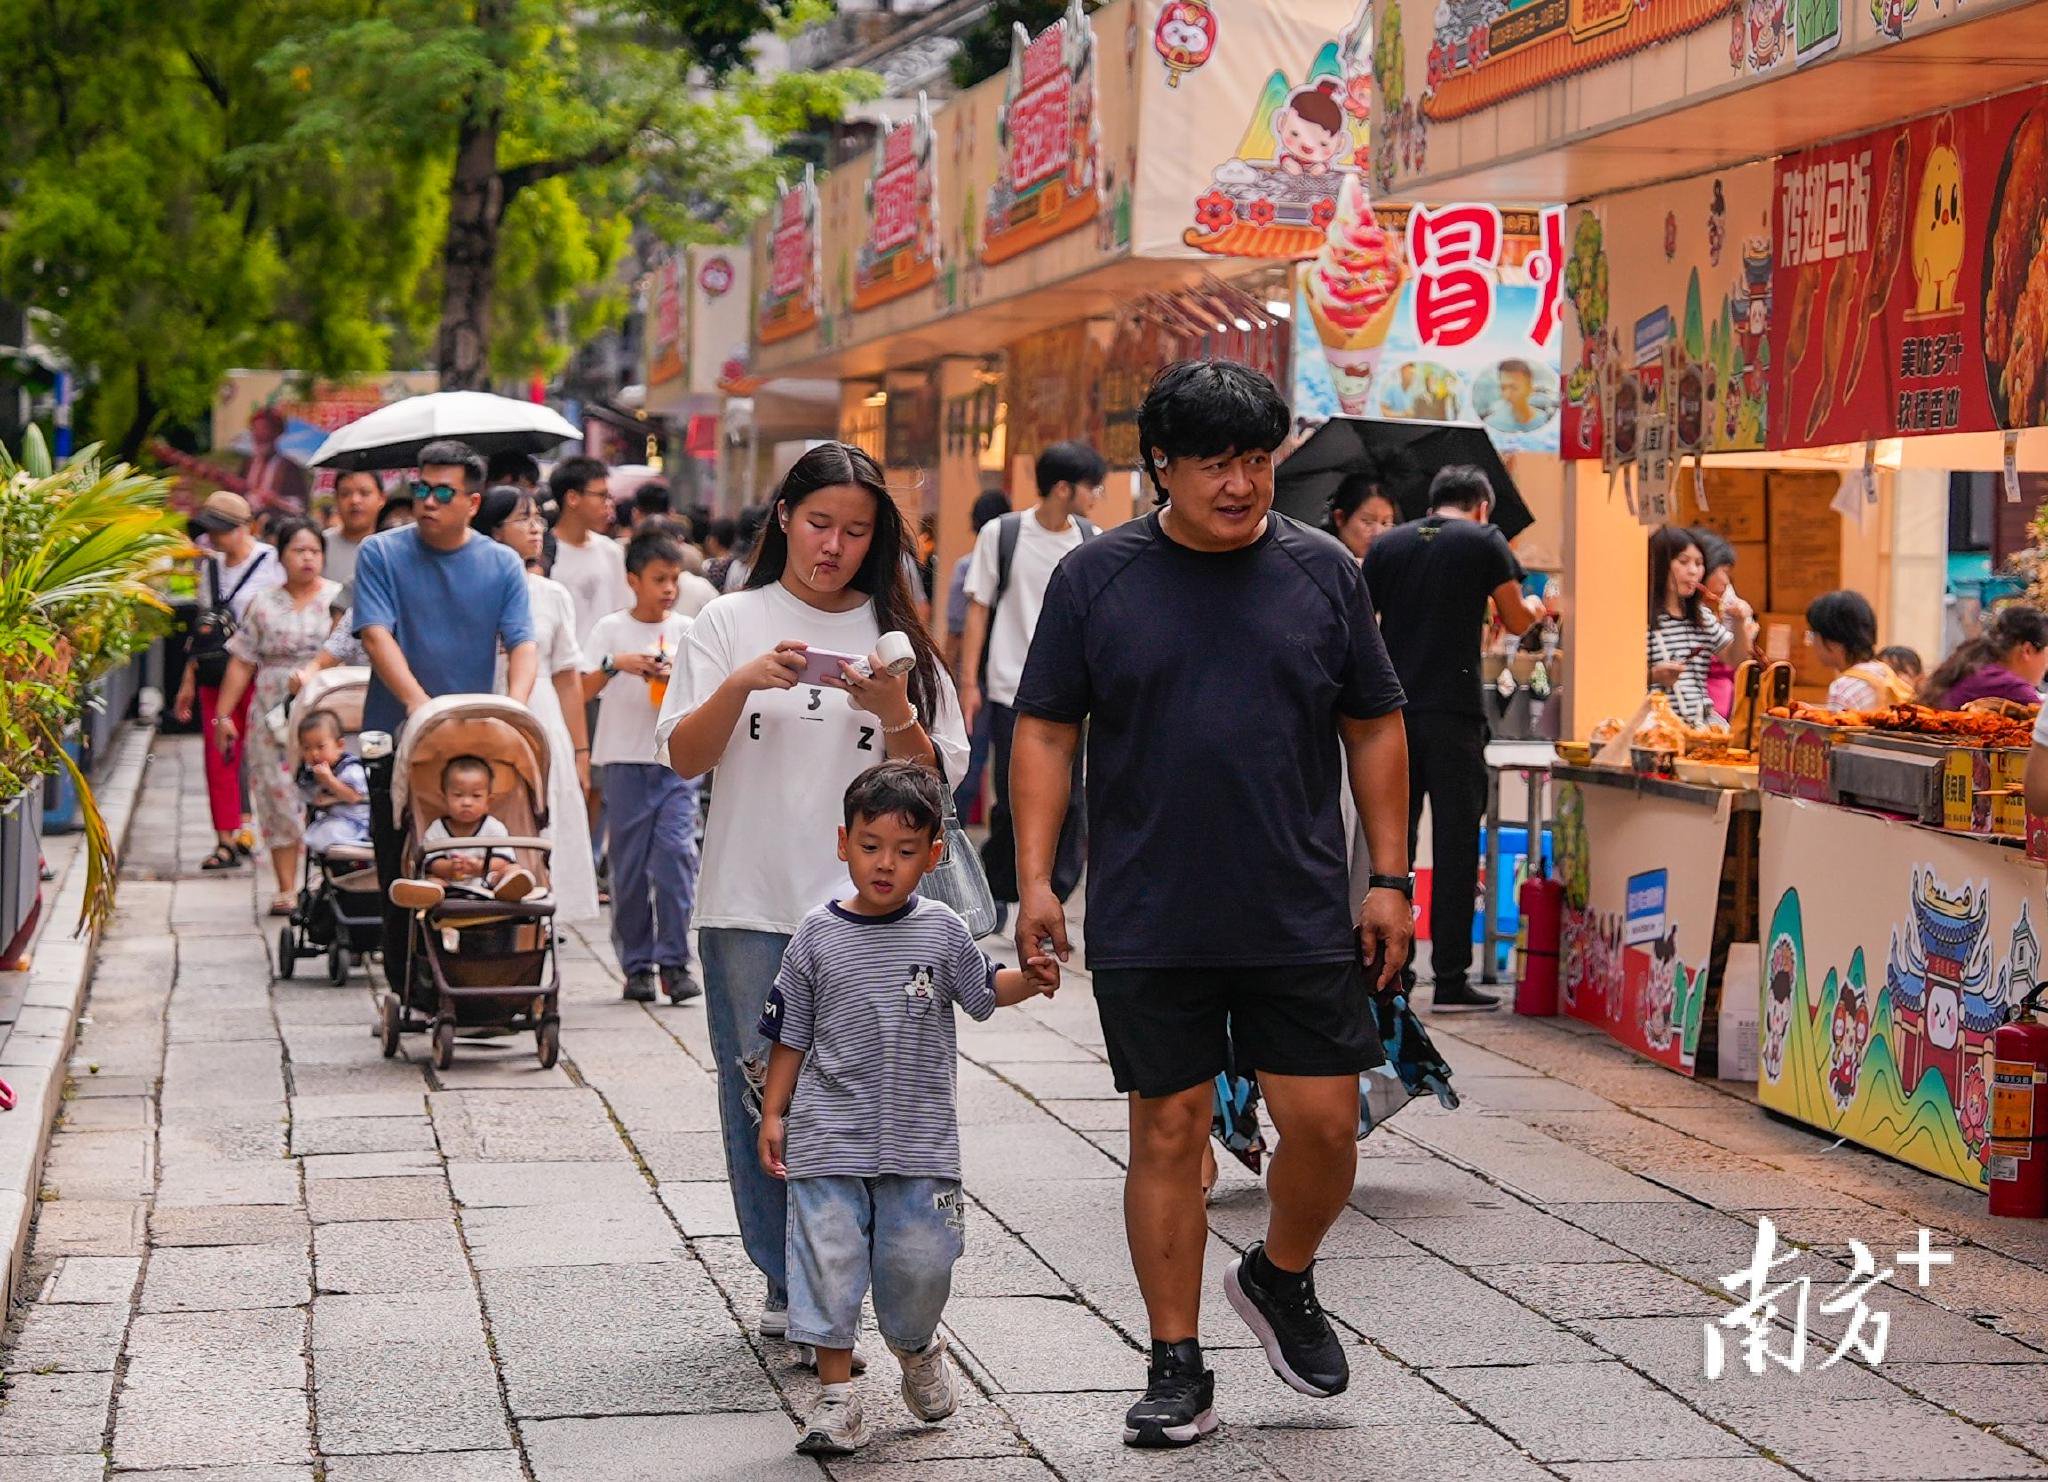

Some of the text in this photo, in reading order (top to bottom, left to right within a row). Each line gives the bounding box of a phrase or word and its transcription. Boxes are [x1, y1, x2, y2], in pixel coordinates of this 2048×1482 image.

[1781, 150, 1872, 268] 鸡翅包饭
[1900, 332, 1964, 379] 美味多汁
[857, 726, 875, 751] Z
[937, 1193, 955, 1210] ART
